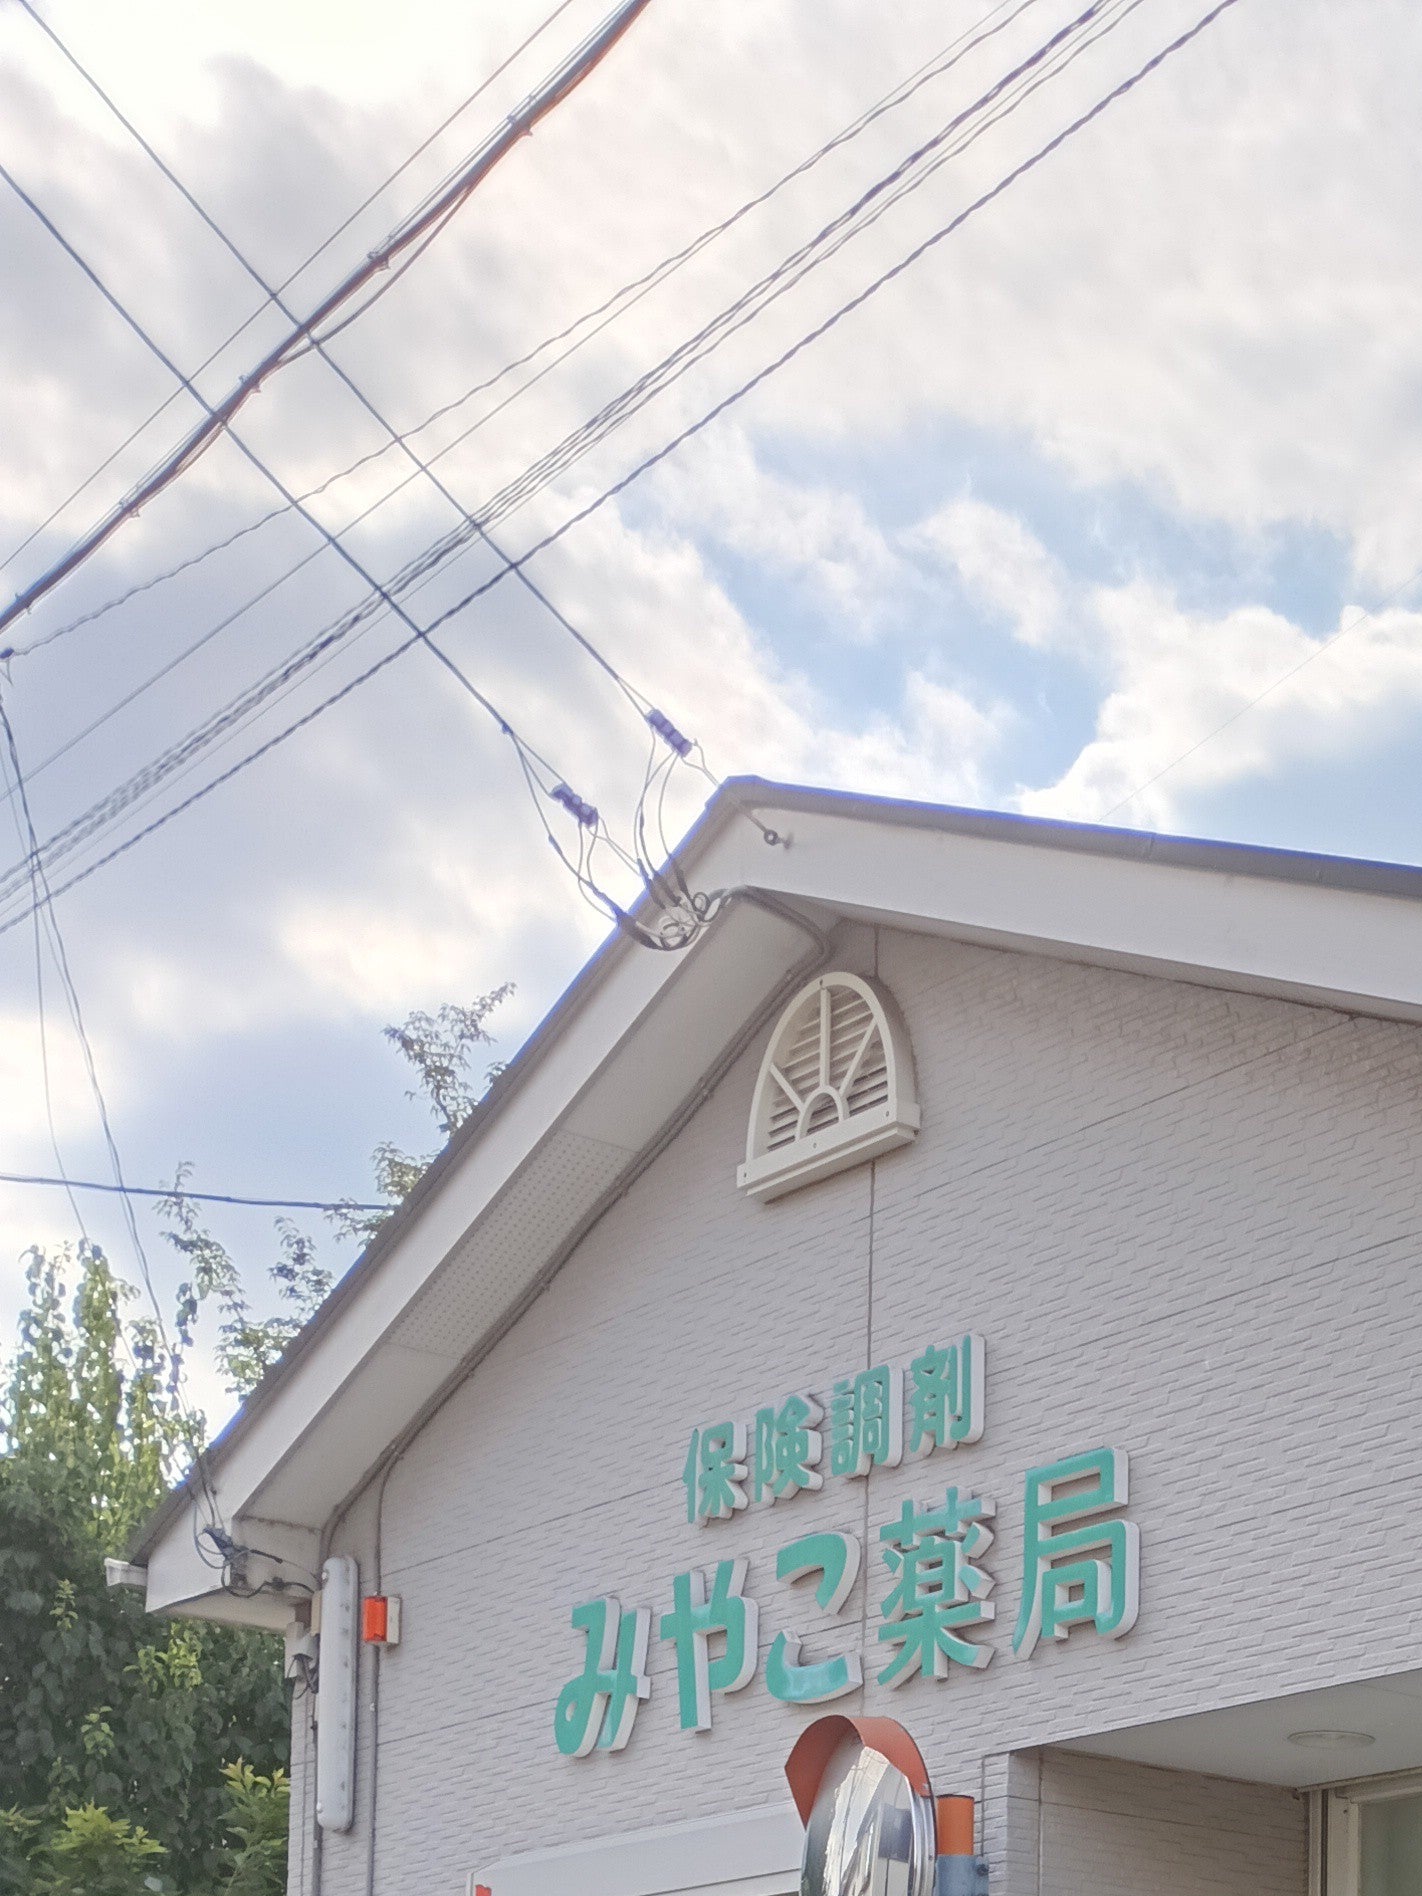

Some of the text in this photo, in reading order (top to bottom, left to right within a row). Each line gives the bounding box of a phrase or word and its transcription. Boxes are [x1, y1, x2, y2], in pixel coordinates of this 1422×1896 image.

[682, 1333, 986, 1527] 保険調剤
[553, 1446, 1140, 1758] みやこ薬局
